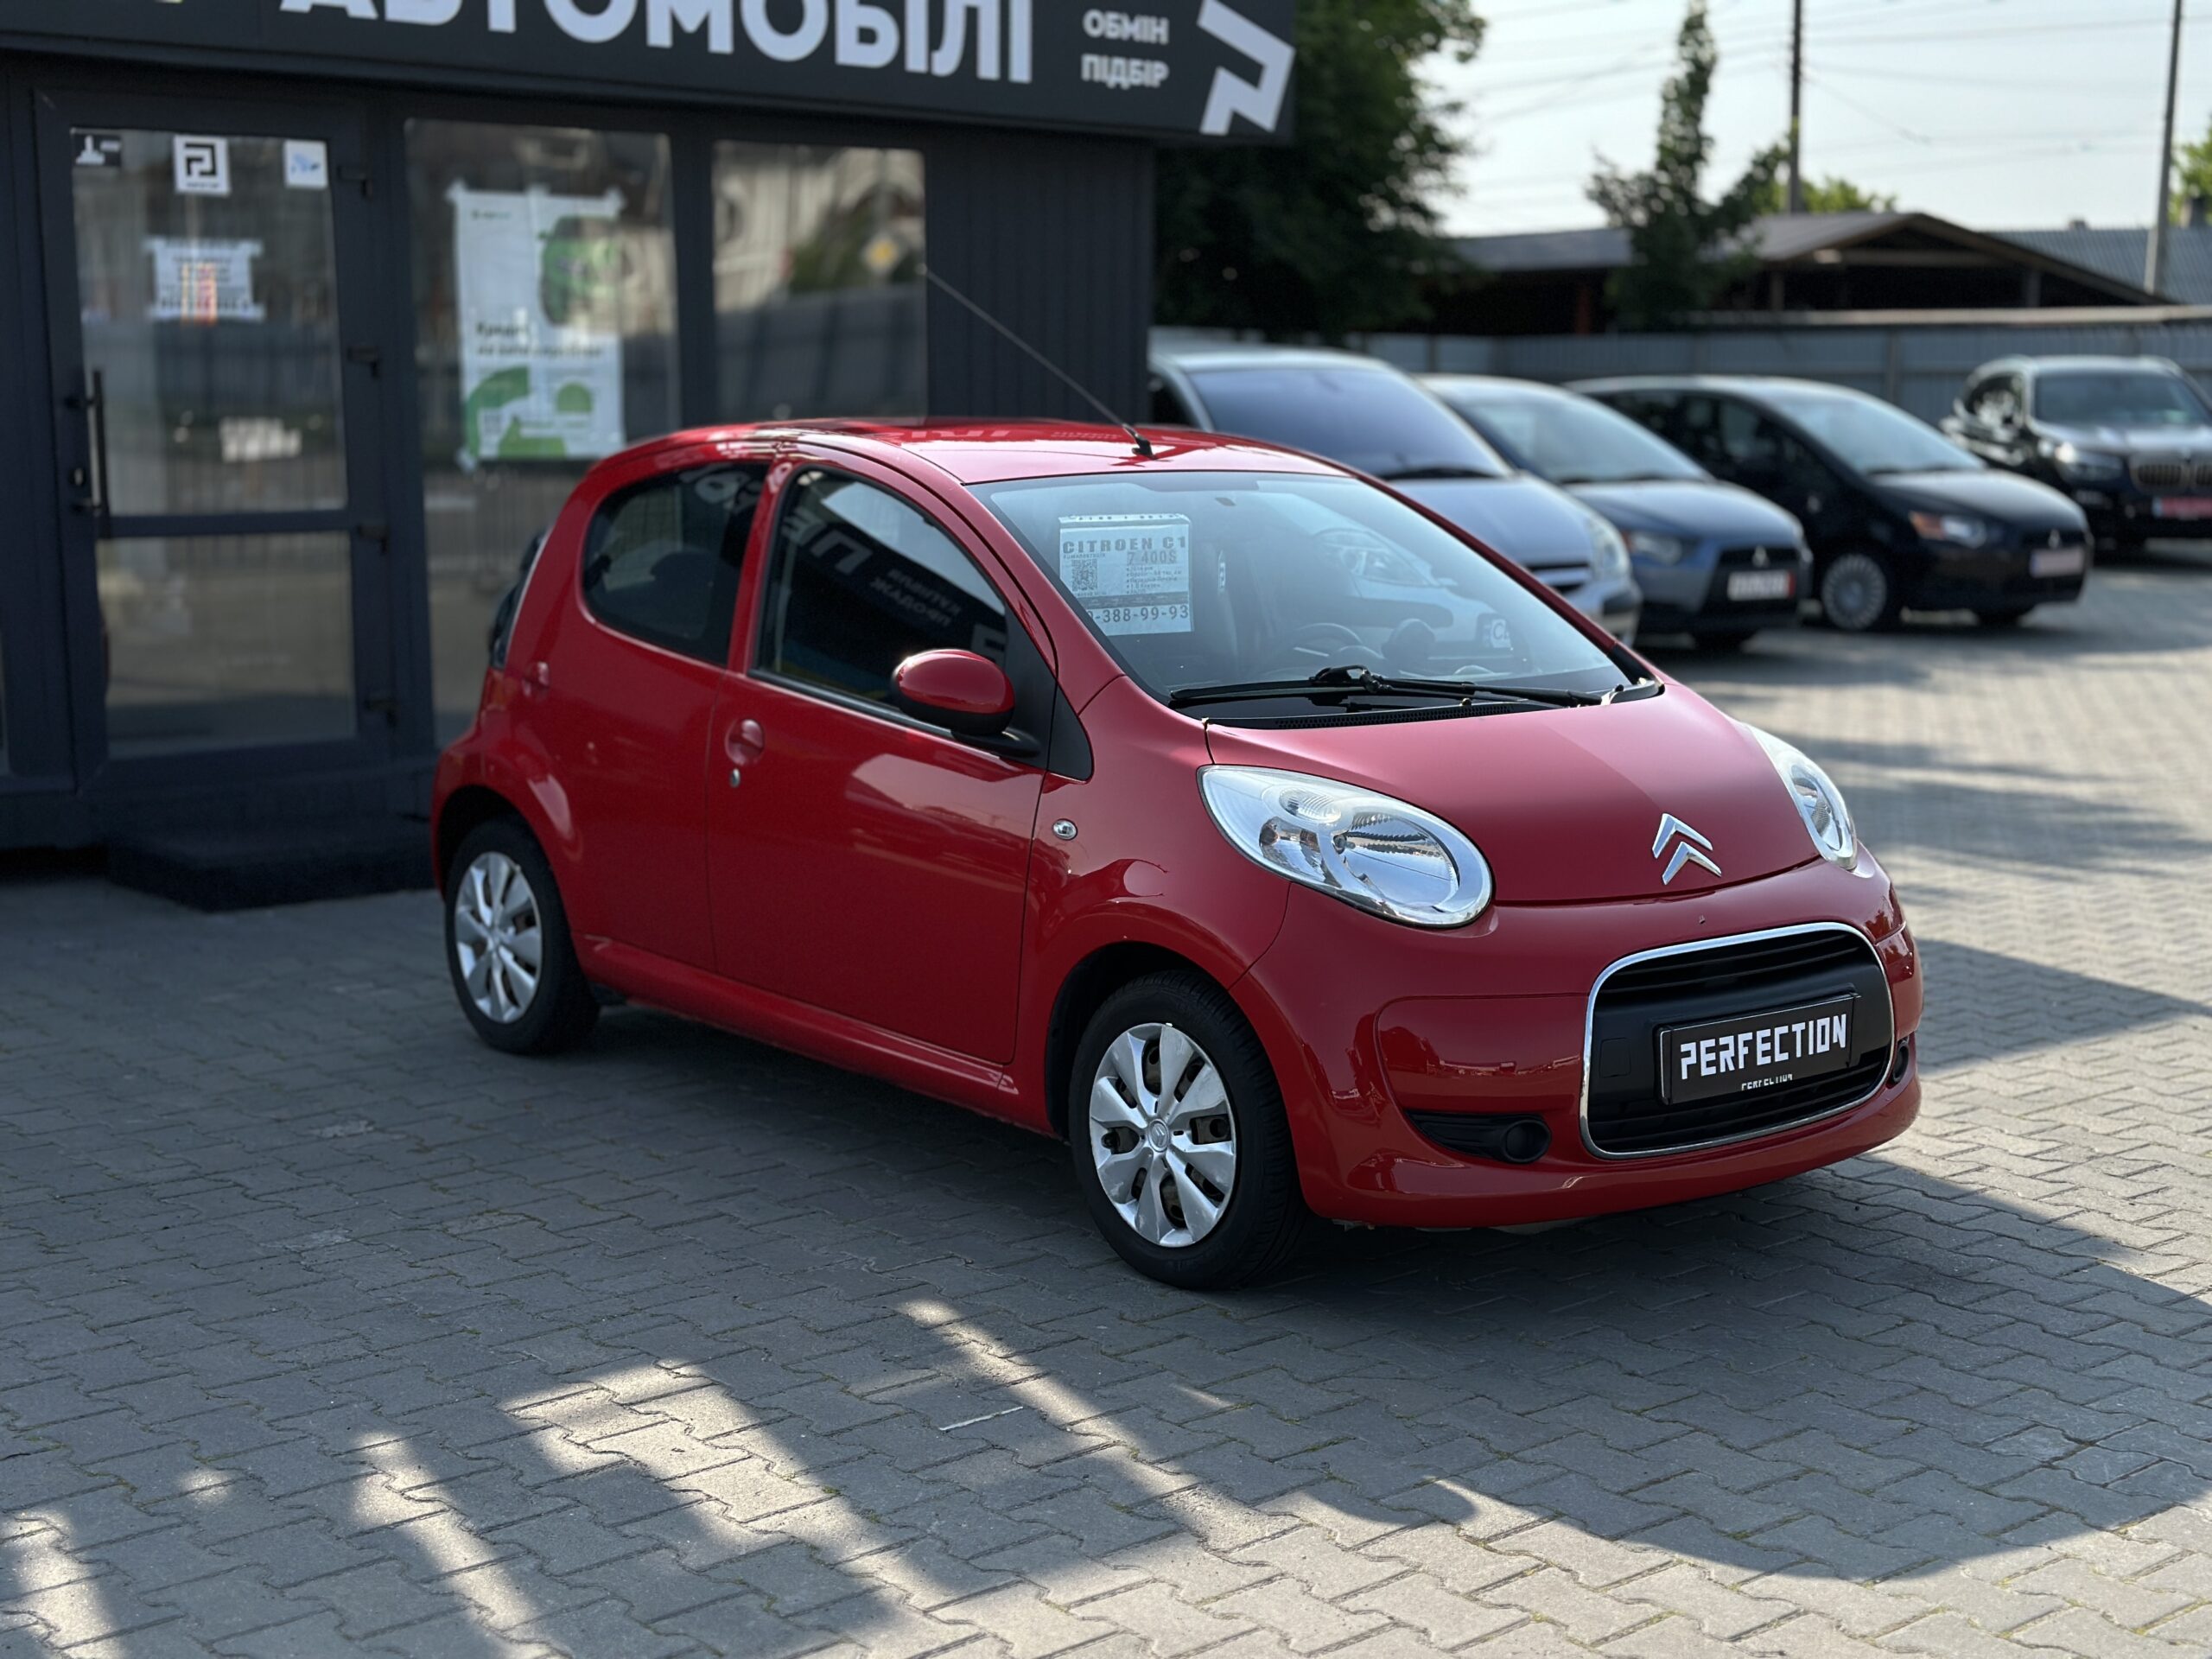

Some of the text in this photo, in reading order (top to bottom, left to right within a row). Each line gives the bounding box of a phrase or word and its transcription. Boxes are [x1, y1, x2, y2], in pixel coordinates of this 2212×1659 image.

[279, 0, 1032, 83] МОБІЛІ
[1082, 9, 1169, 44] ОБМІН
[1081, 53, 1169, 89] ПІДБІР
[1063, 536, 1186, 554] CITROEN C1
[1681, 1014, 1847, 1079] PERFECTION
